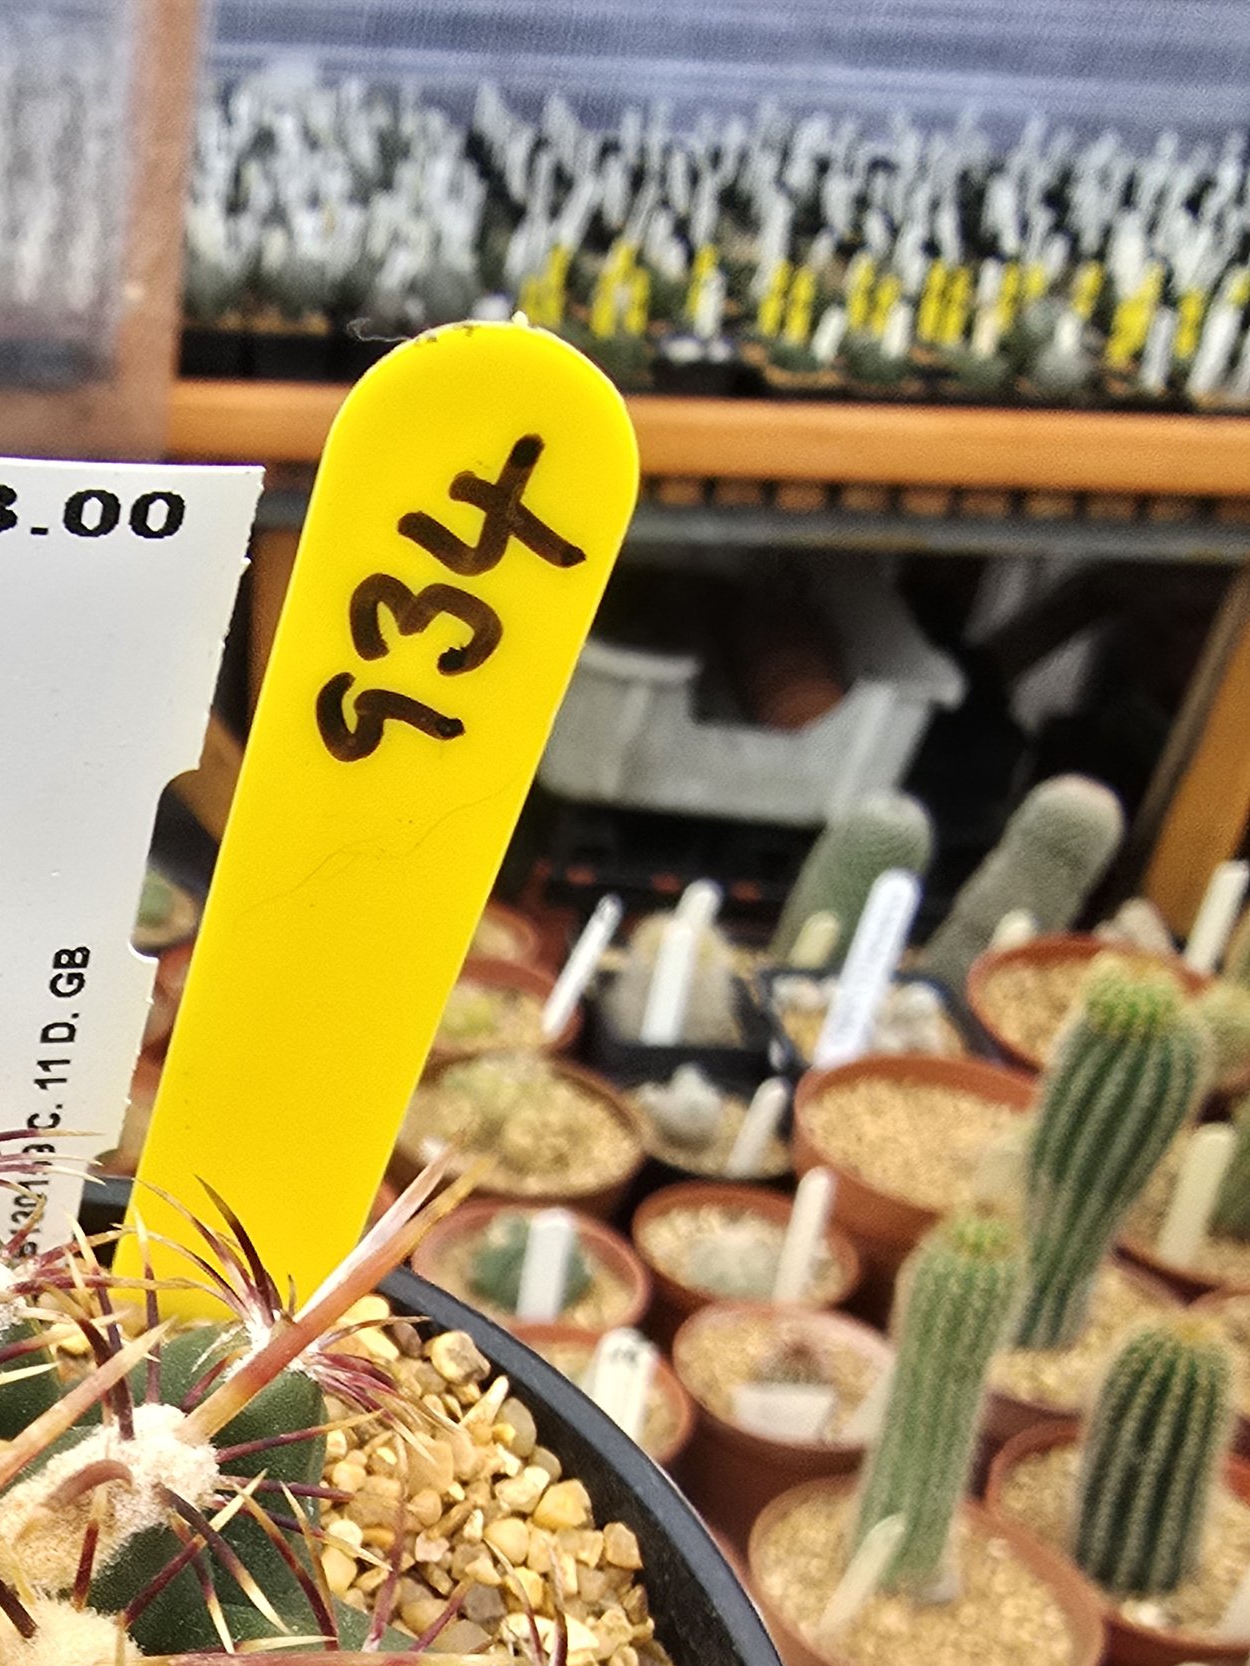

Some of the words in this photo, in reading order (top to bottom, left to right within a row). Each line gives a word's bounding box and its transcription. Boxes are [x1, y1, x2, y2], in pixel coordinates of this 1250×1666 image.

[316, 432, 587, 763] 934
[48, 946, 91, 999] GB
[39, 1012, 80, 1044] D.
[33, 1058, 72, 1091] 11
[26, 1103, 64, 1130] C.
